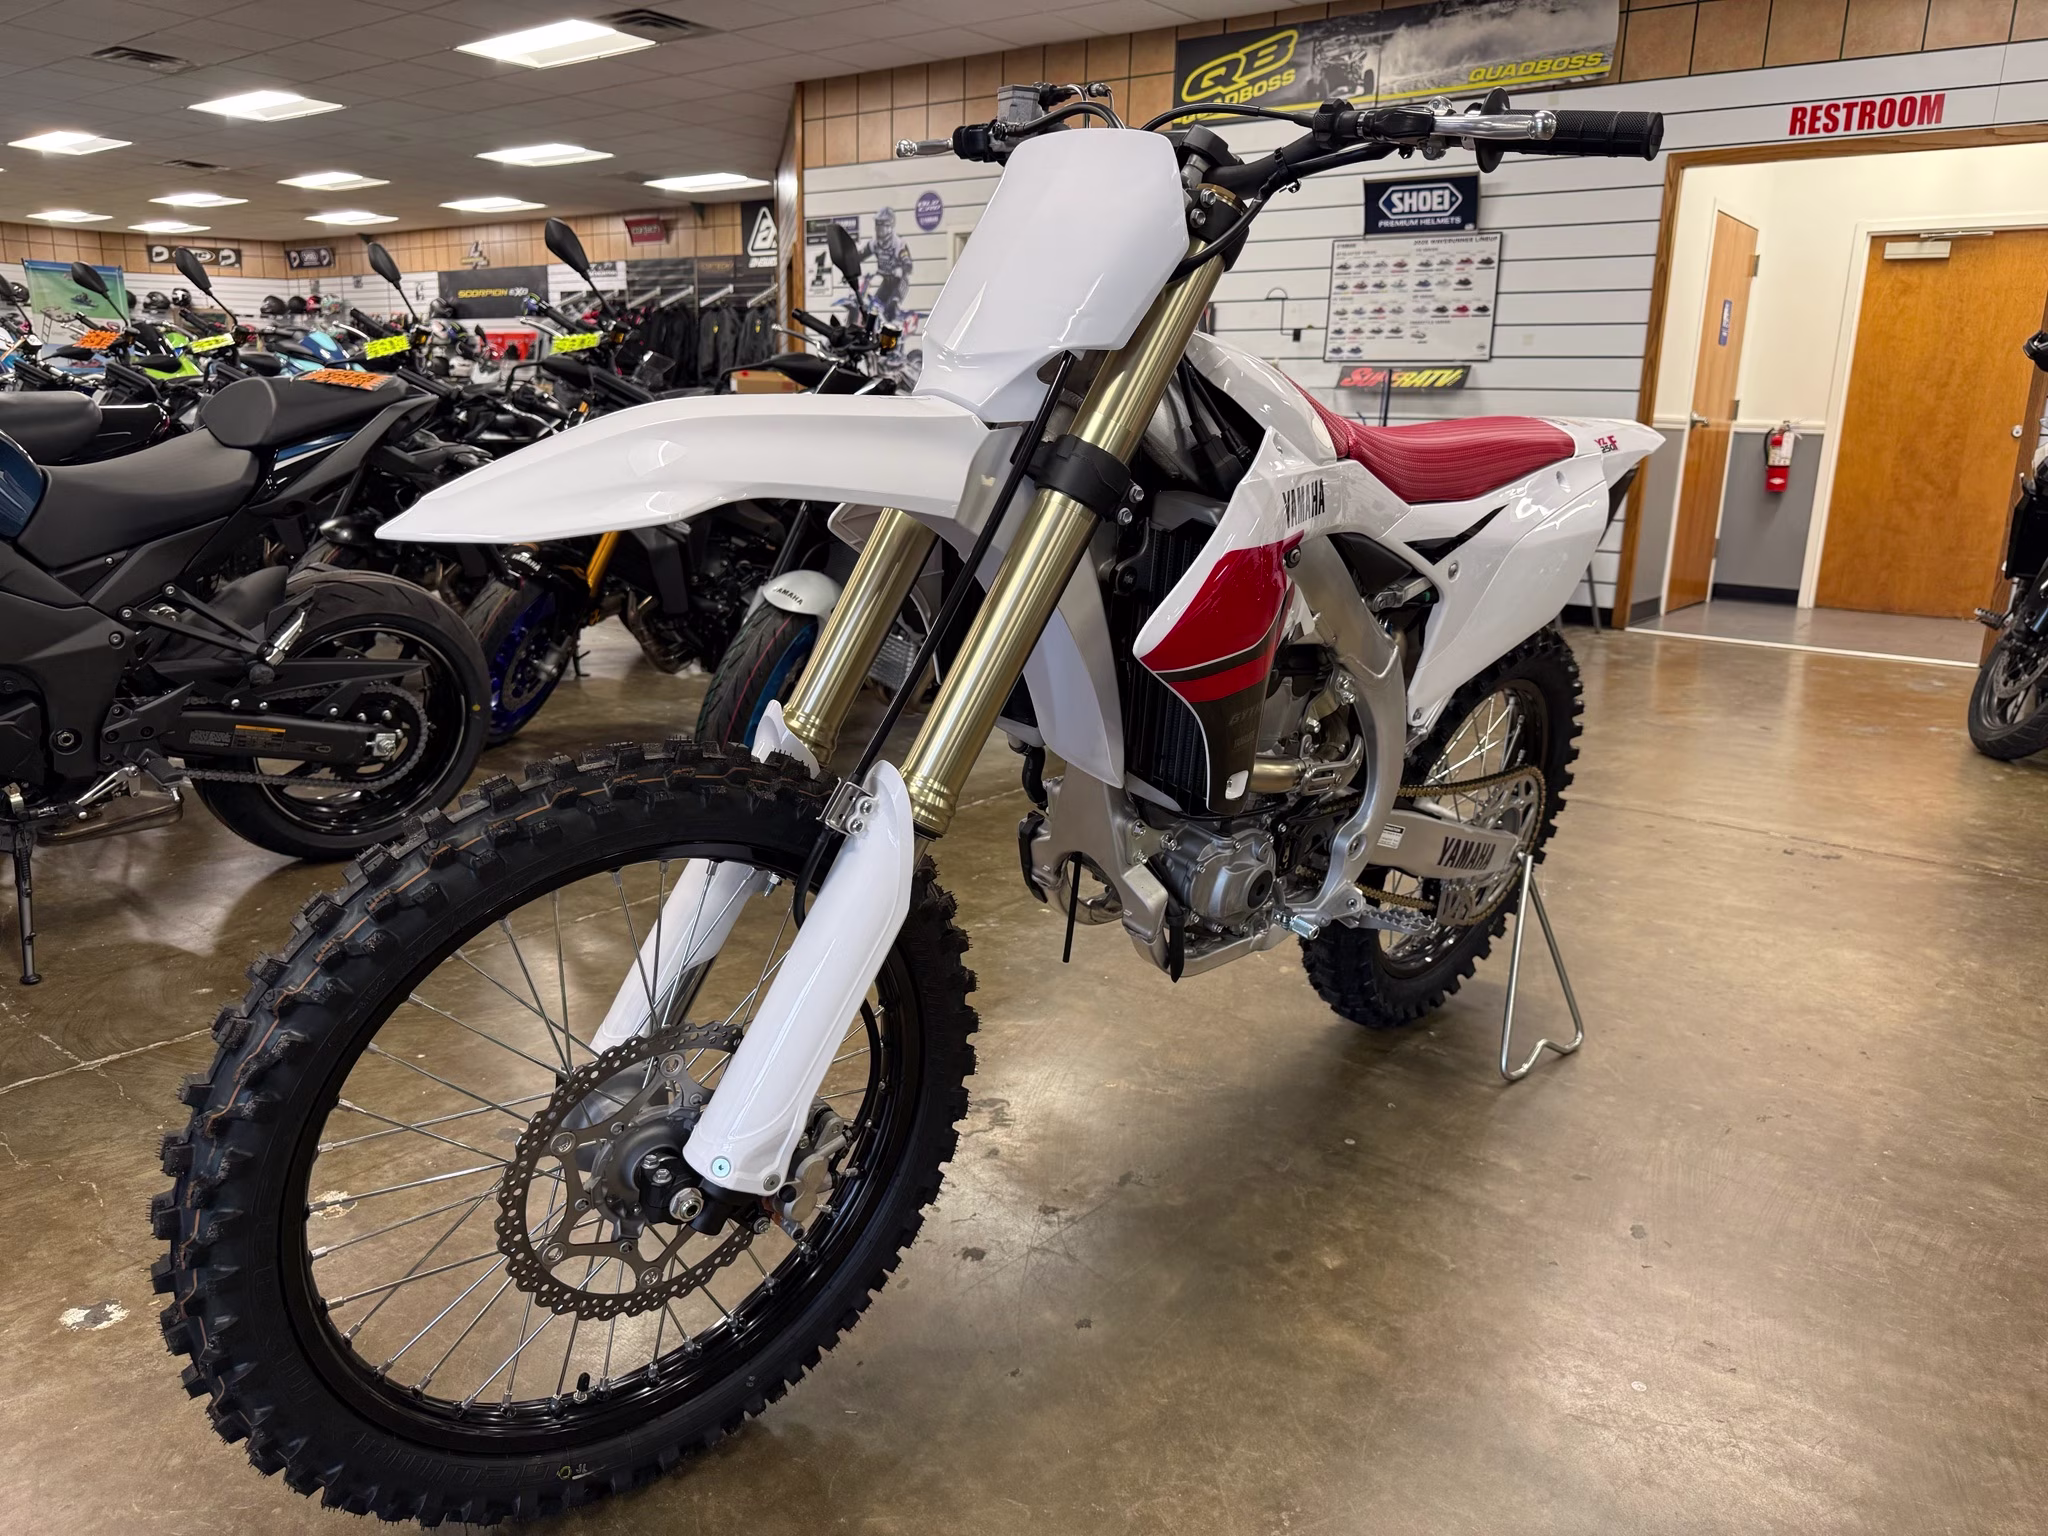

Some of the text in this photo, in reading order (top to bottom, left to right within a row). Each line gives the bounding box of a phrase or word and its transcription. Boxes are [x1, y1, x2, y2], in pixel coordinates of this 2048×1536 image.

[1182, 29, 1299, 102] QB
[1469, 52, 1604, 82] QUADBOSS
[1789, 93, 1946, 136] RESTROOM
[1391, 189, 1451, 213] SHOEI
[1378, 216, 1462, 229] PREMIUM HELMETS
[458, 288, 508, 299] SCORPION
[1282, 478, 1325, 529] YAMAHA
[1437, 836, 1497, 870] YAMAHA
